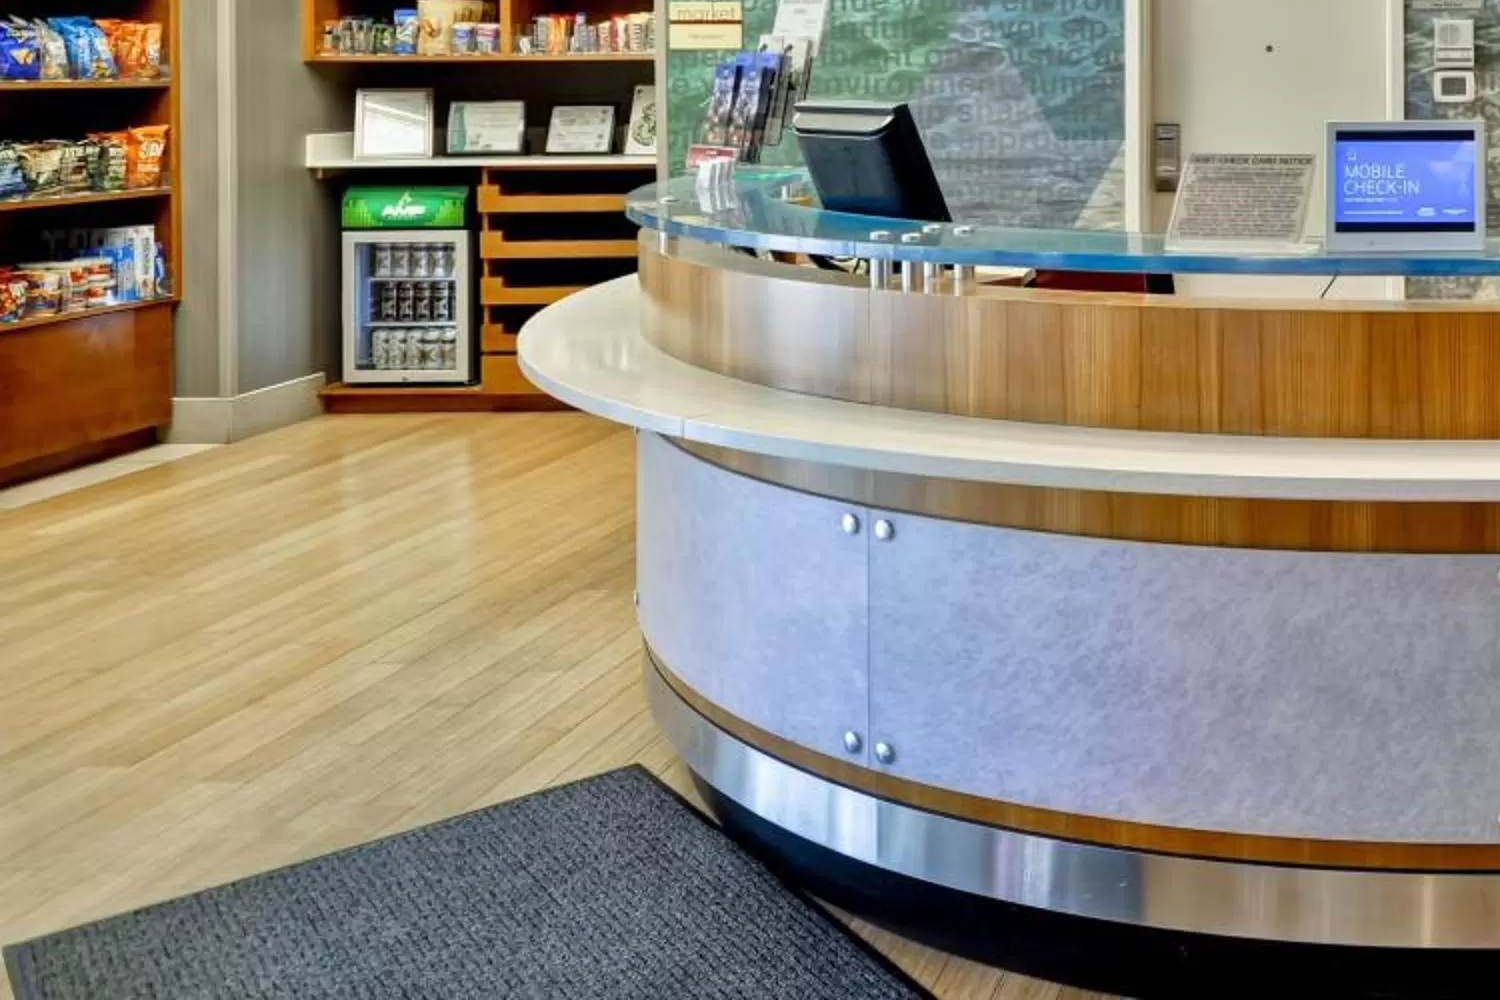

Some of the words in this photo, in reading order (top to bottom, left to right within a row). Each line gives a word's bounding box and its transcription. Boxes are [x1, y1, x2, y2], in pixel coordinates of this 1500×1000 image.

[677, 0, 737, 19] market
[1344, 163, 1406, 179] MOBILE
[1343, 180, 1420, 195] CHECK-IN
